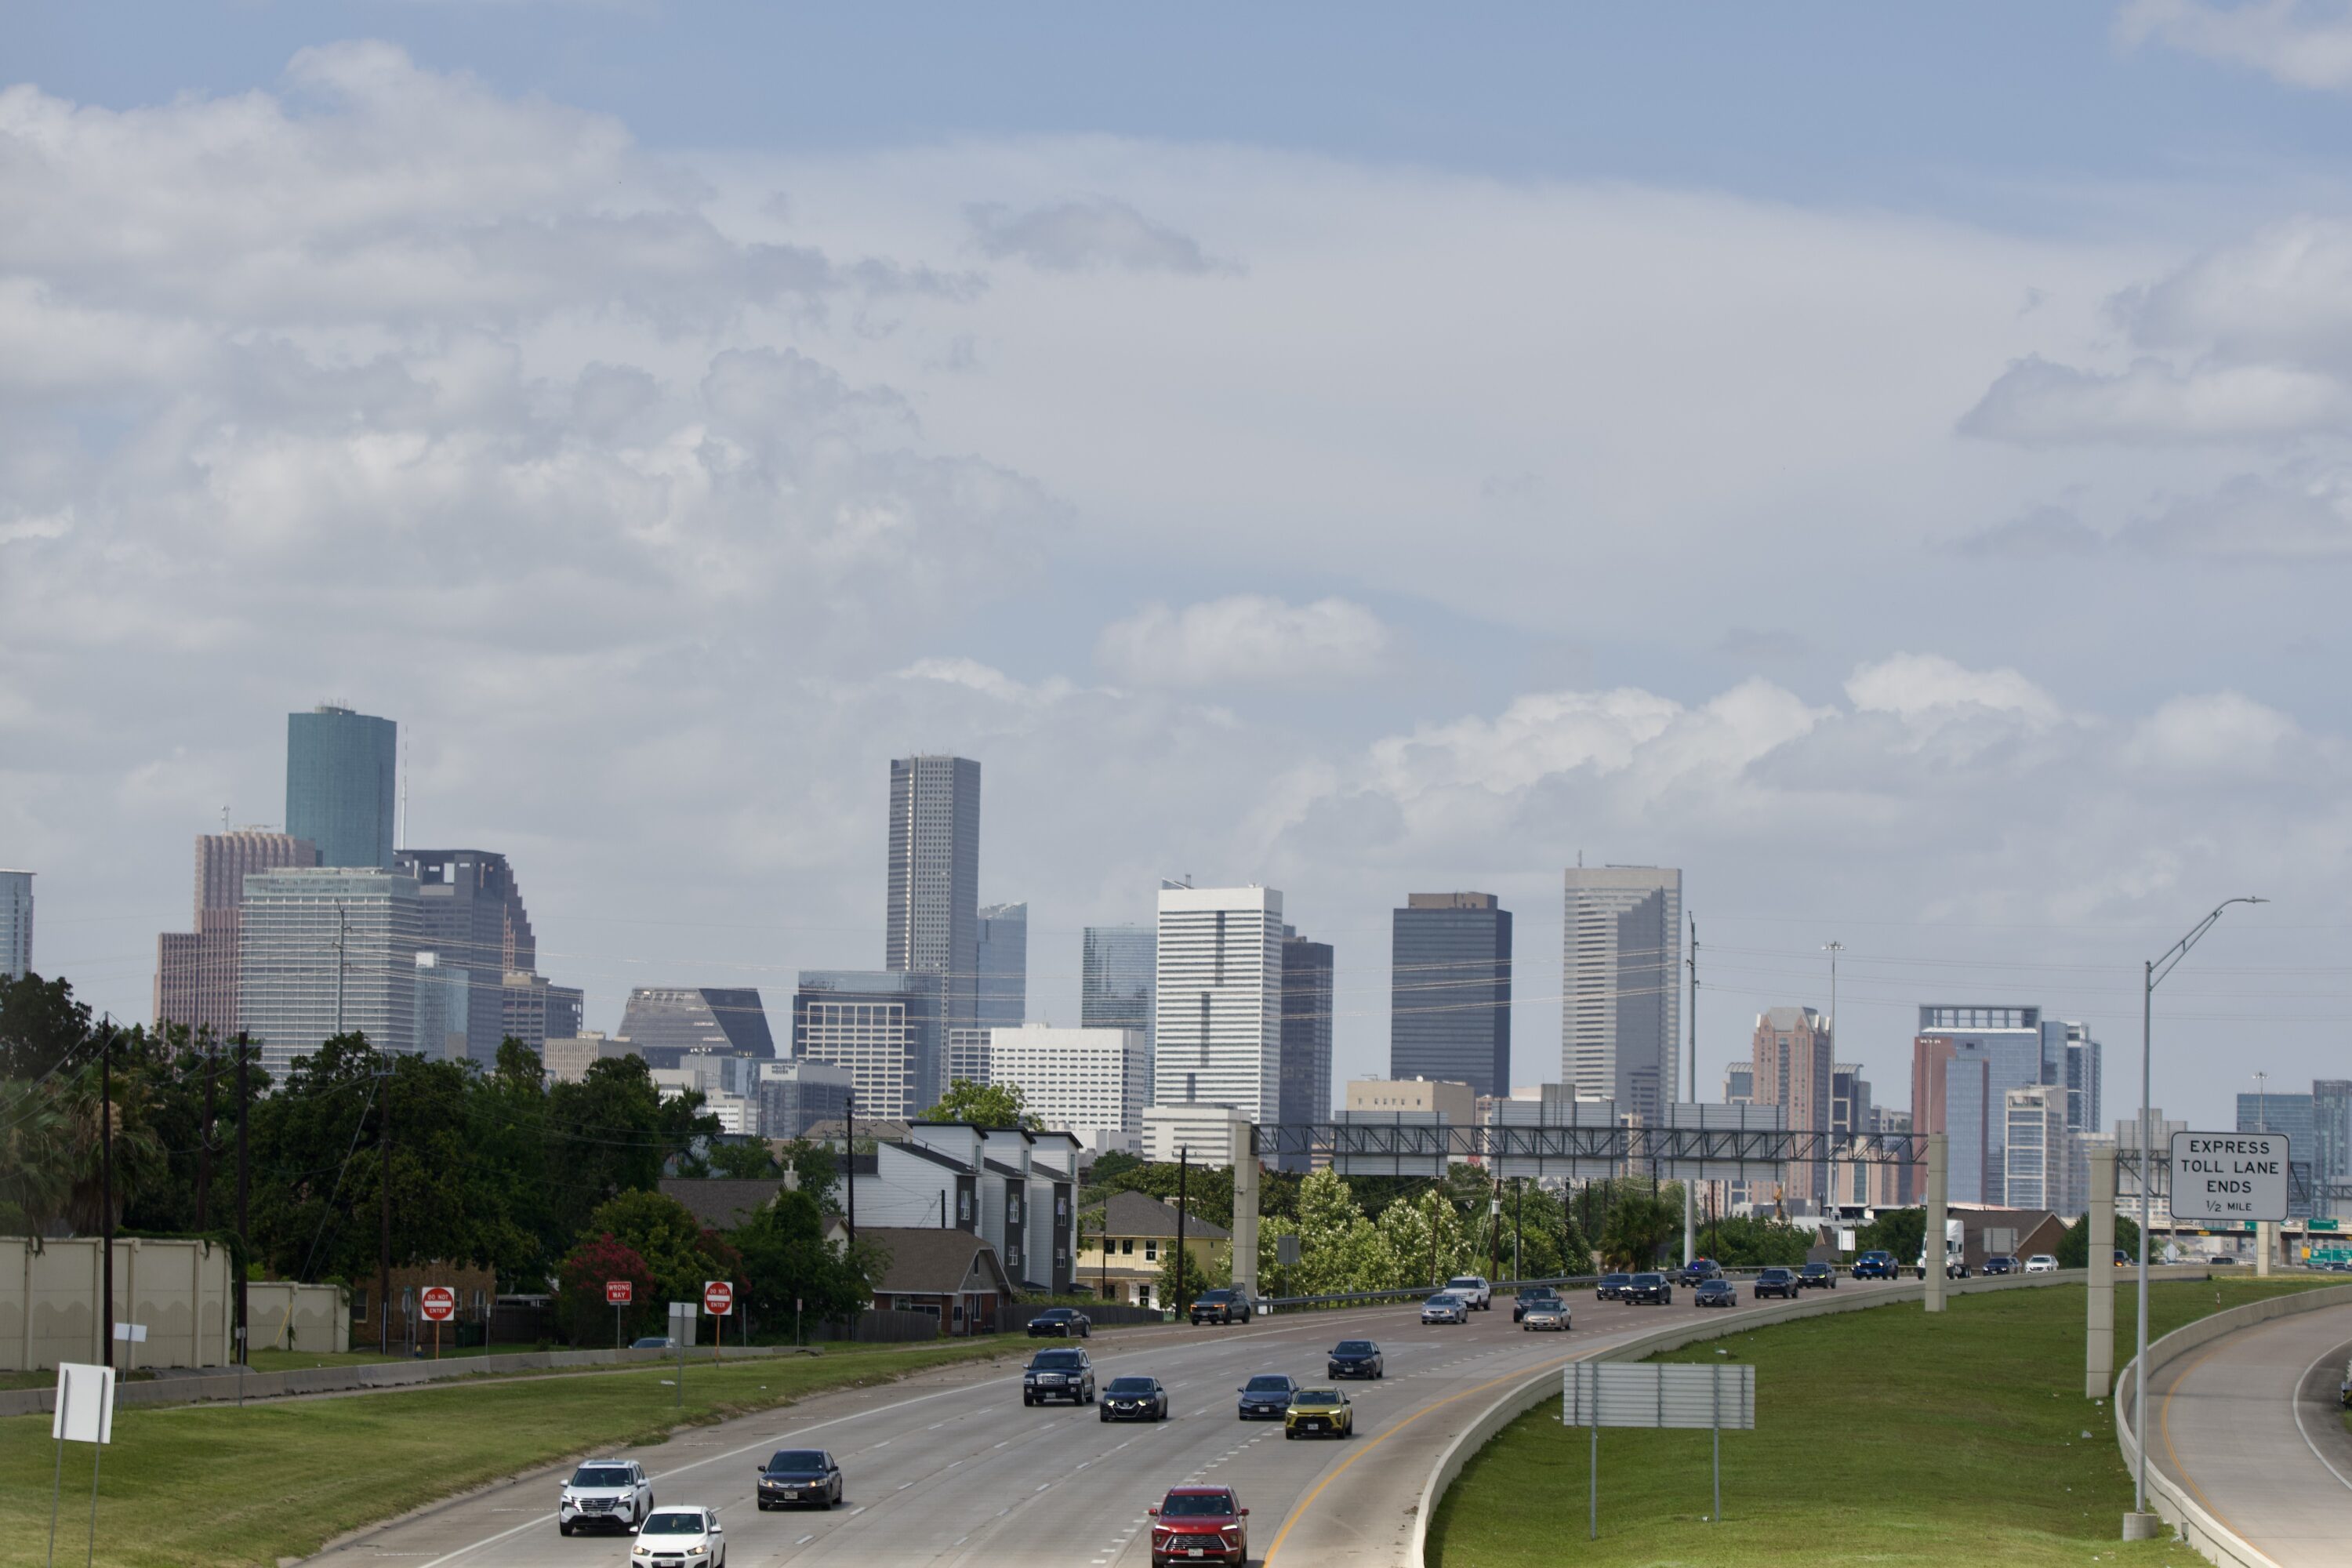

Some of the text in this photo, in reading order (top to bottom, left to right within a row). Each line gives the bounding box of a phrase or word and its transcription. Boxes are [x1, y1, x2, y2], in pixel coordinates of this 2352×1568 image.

[2190, 1140, 2270, 1154] EXPRESS
[2181, 1160, 2279, 1174] TOLL LANE
[2207, 1180, 2252, 1193] ENDS
[2227, 1203, 2252, 1211] MILE
